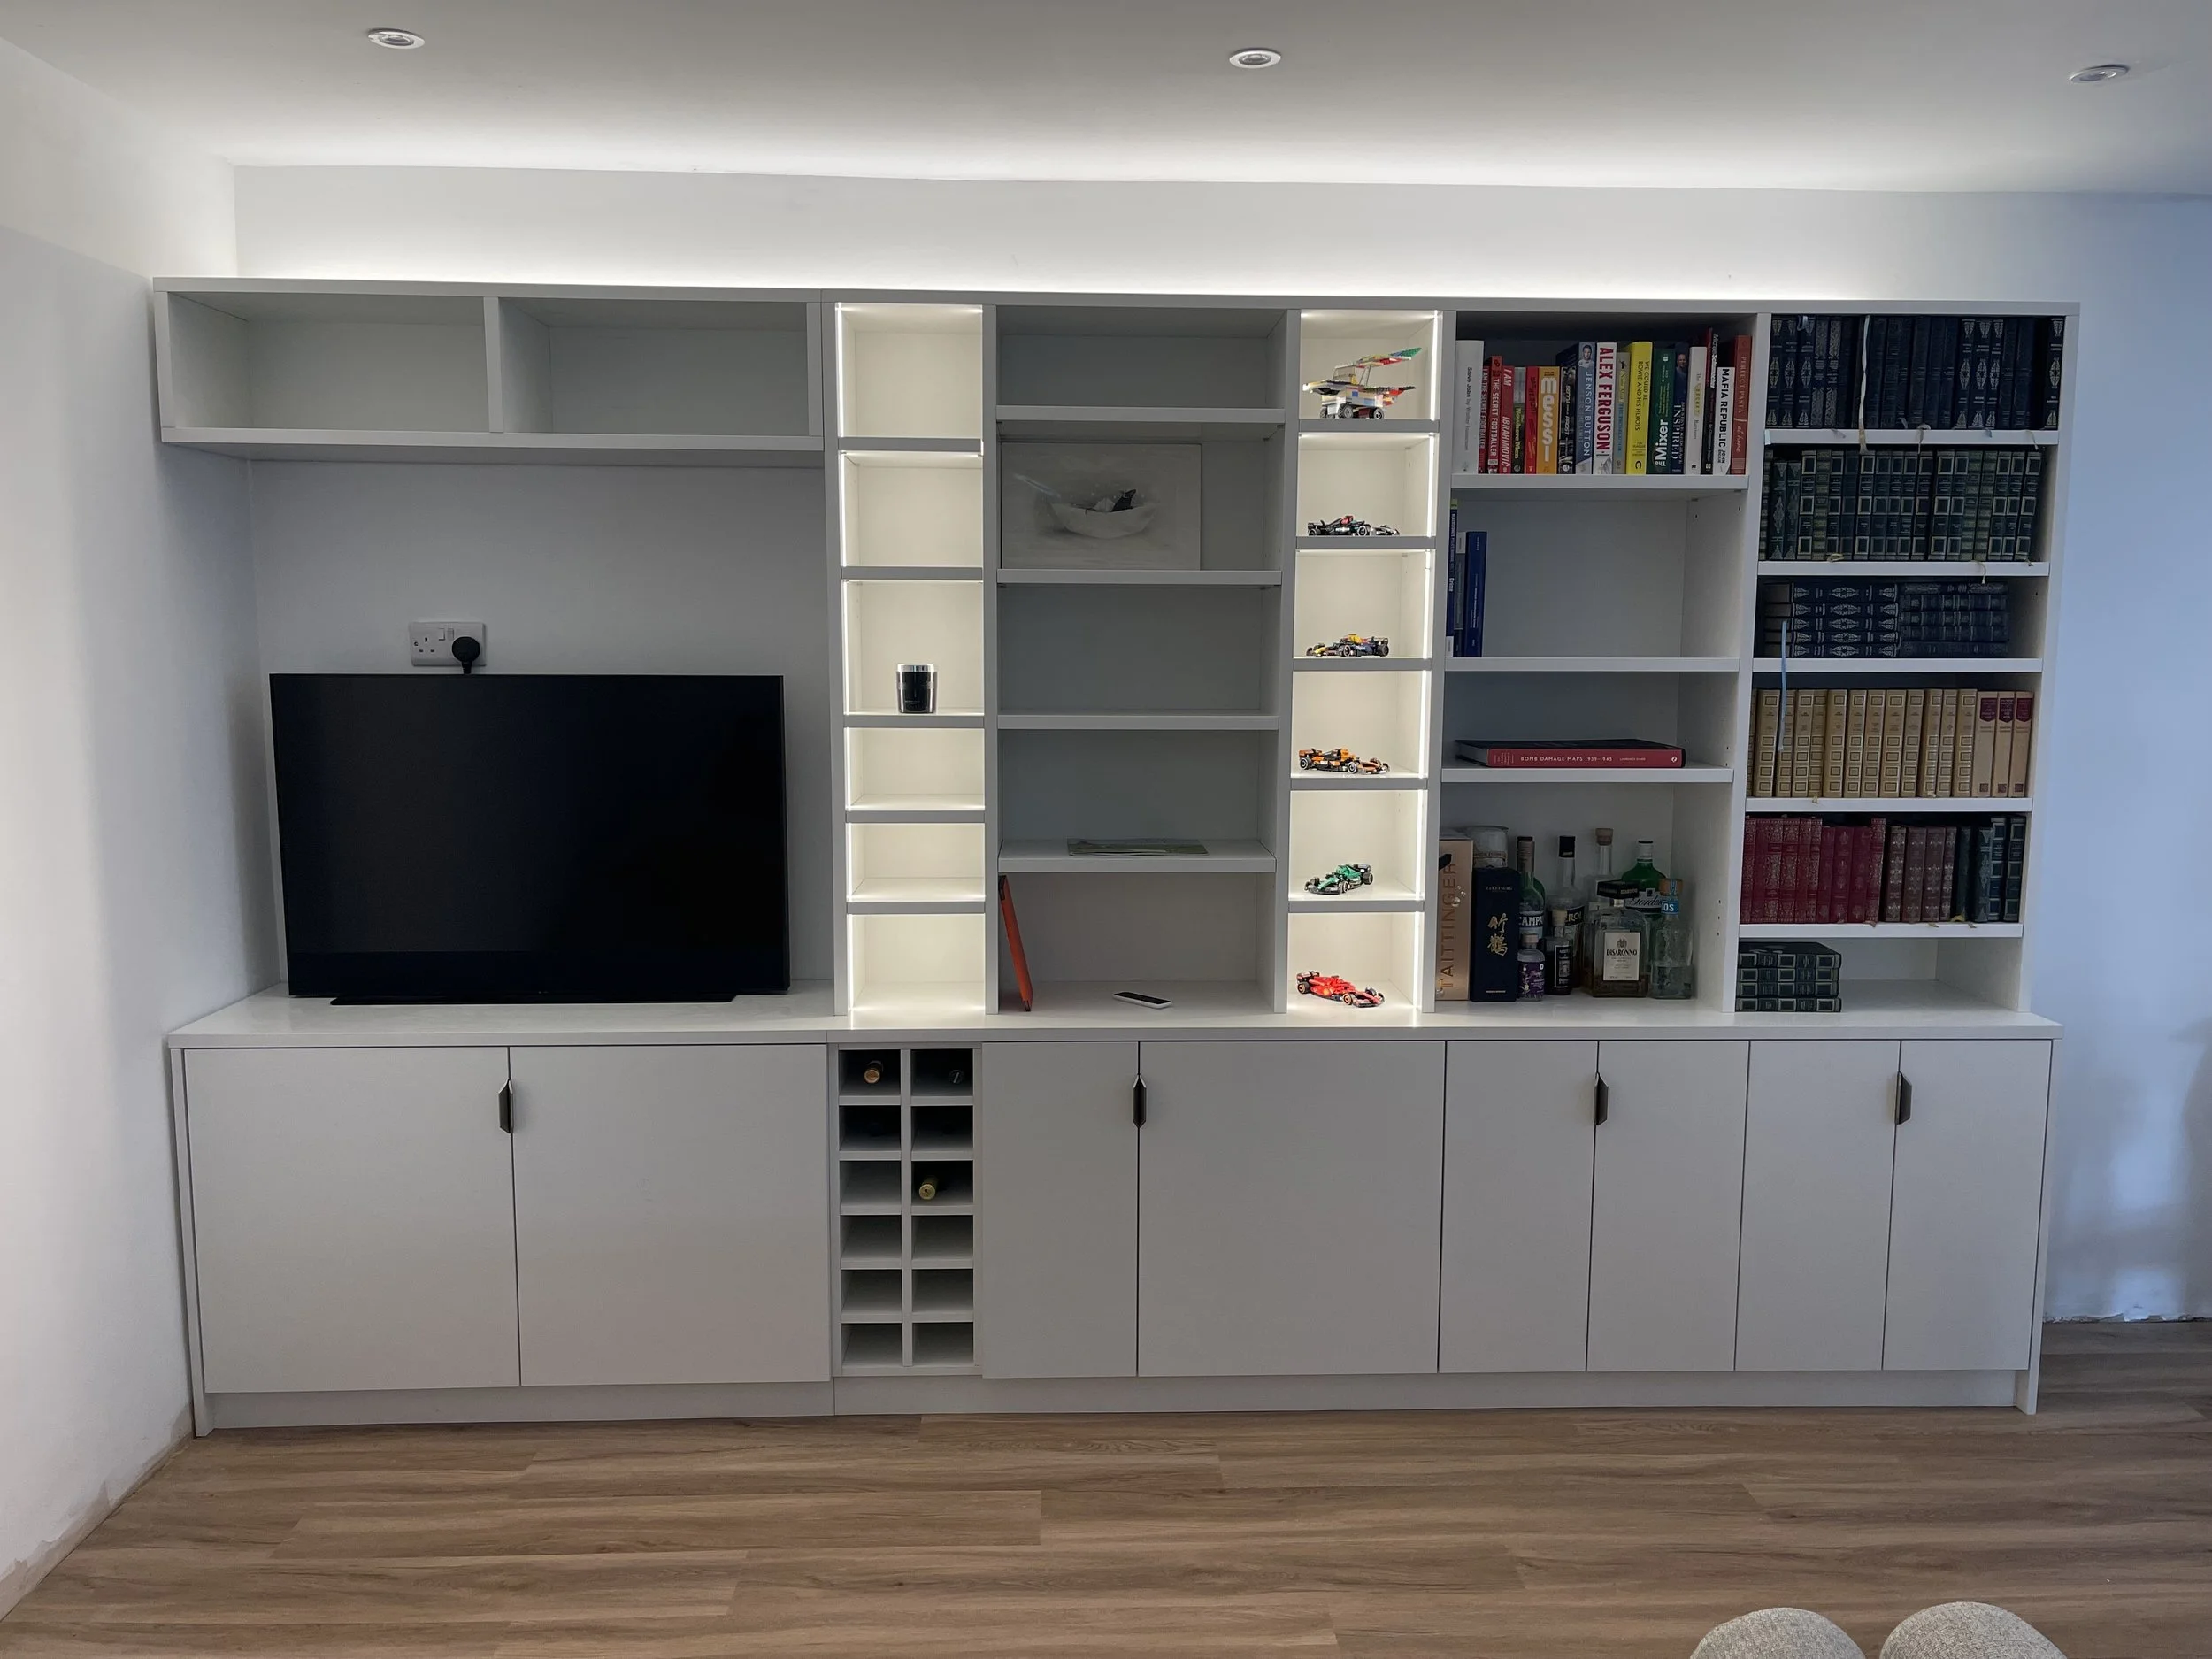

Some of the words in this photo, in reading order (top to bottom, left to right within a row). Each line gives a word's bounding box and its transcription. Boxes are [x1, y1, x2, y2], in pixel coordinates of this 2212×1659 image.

[1503, 374, 1511, 386] AM
[1599, 348, 1614, 379] ALEX
[1644, 361, 1649, 370] WE
[1720, 368, 1730, 398] MAFIA
[1596, 384, 1612, 450] FERGUSON
[1671, 404, 1681, 459] INSPIRED
[1718, 401, 1728, 448] REPUBLIC
[1502, 416, 1510, 467] IBRAHIMOVIĆ
[1655, 419, 1668, 461] Mixer
[1440, 863, 1456, 988] TAITTINGER
